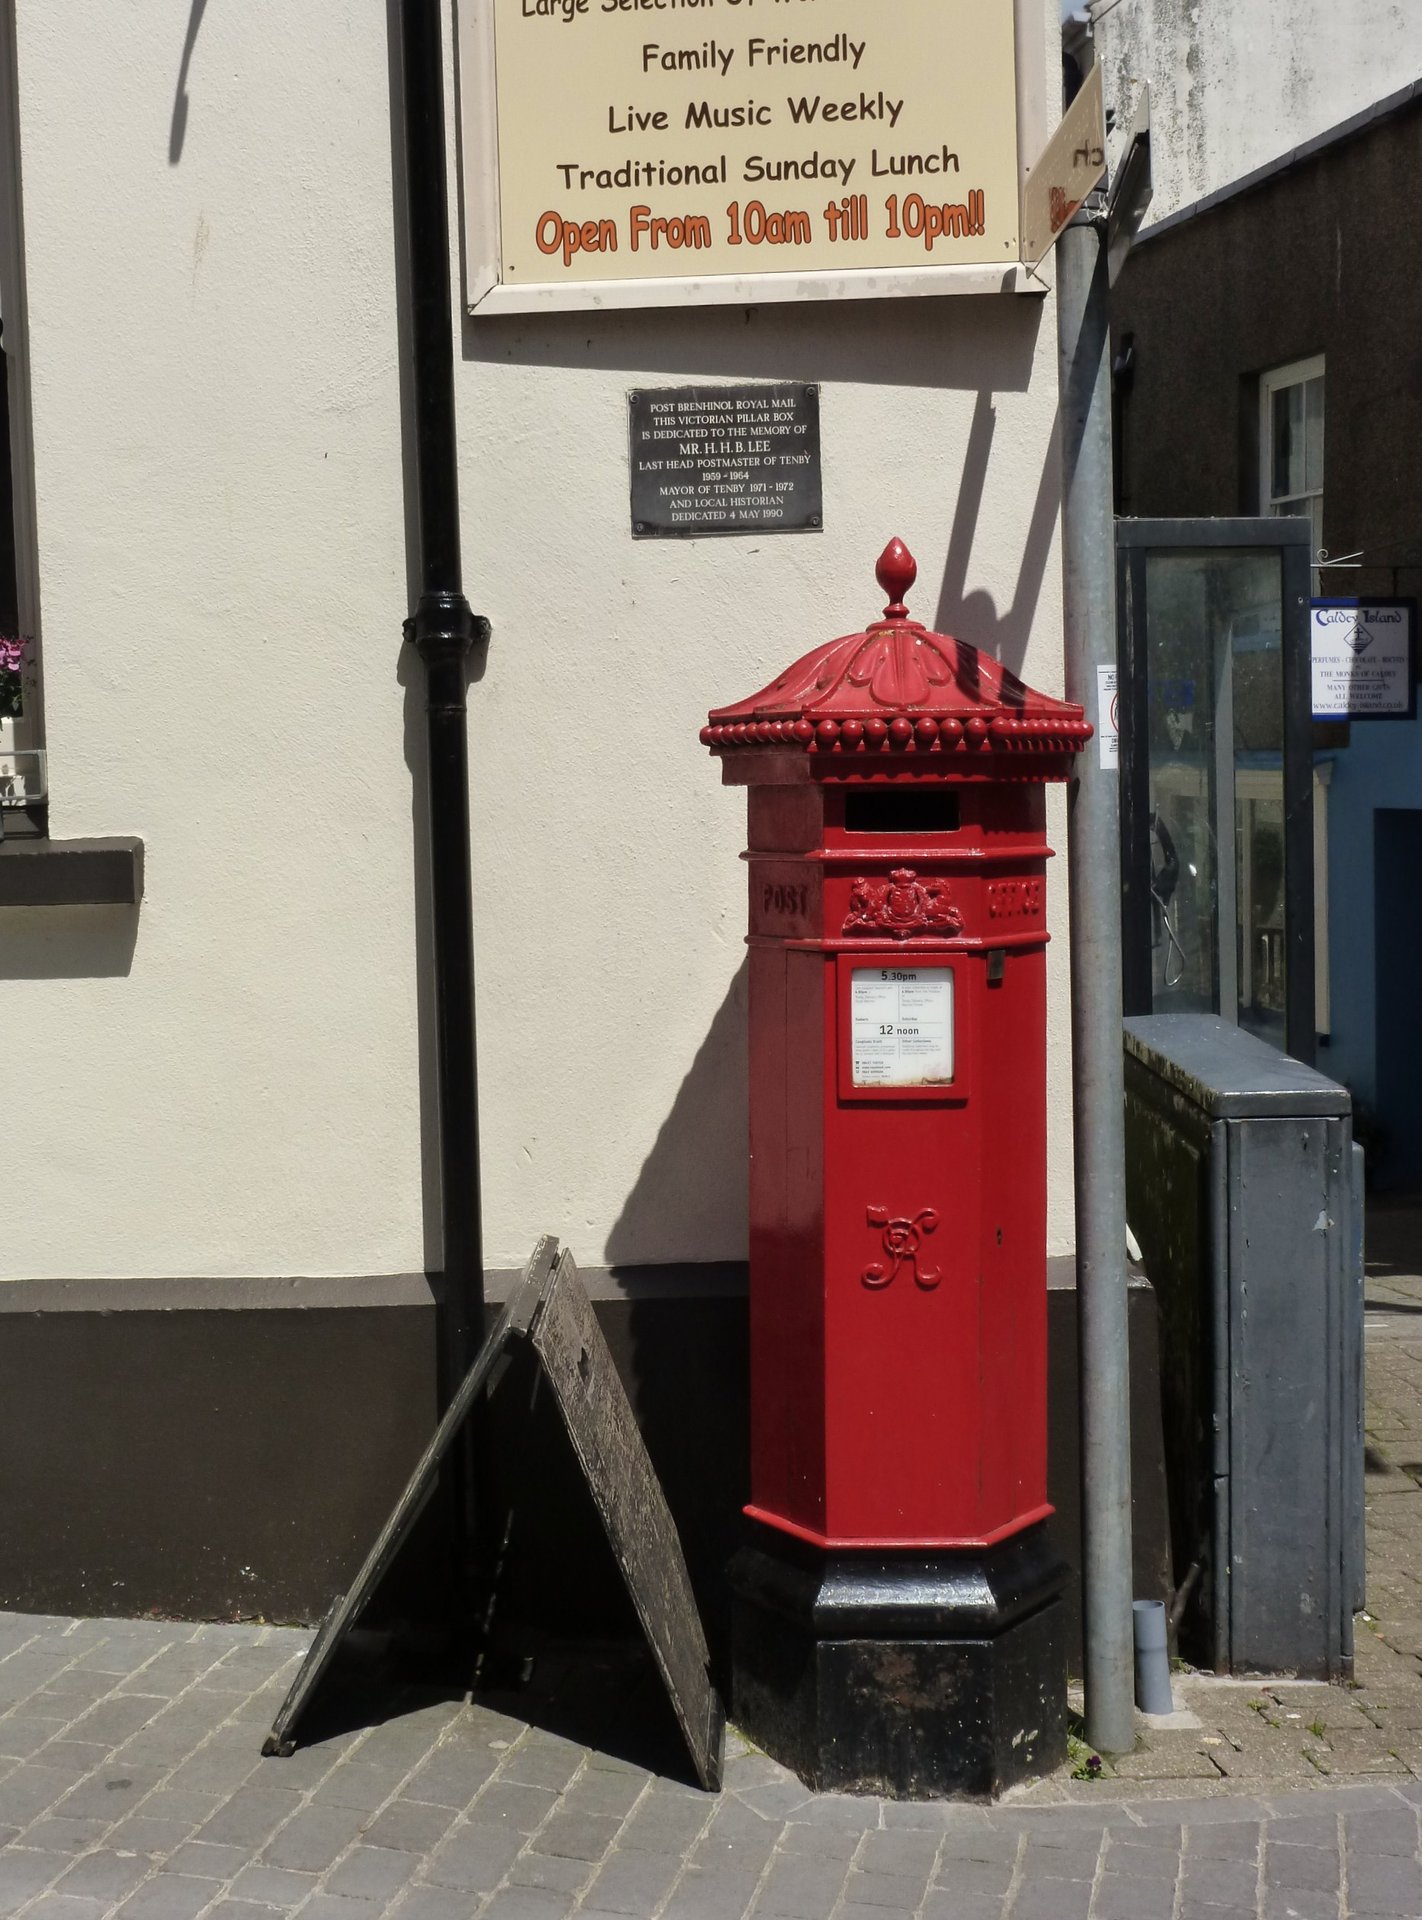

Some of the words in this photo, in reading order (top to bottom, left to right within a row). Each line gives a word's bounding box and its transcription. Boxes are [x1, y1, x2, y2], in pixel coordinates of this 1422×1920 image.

[642, 40, 735, 77] Family
[748, 32, 866, 70] Friendly
[608, 105, 669, 134] Live
[684, 99, 772, 130] Music
[786, 91, 904, 128] Weekly
[556, 154, 727, 190] Traditional
[743, 151, 856, 187] Sunday
[871, 144, 960, 177] Lunch
[535, 210, 618, 268] Open
[629, 204, 712, 252] From
[726, 199, 812, 246] 10am
[822, 193, 869, 243] till
[884, 188, 986, 252] 10pm!!
[651, 403, 675, 412] POST
[678, 401, 733, 412] BRENHINOL
[736, 400, 769, 409] ROYAL
[771, 399, 796, 408] MAIL
[653, 417, 675, 426] THIS
[678, 415, 733, 425] VICTORIAN
[737, 414, 770, 423] PILLAR
[773, 412, 794, 421] BOX
[642, 431, 650, 440] IS
[654, 429, 708, 439] DEDICATED
[711, 428, 725, 437] TO
[729, 428, 747, 436] THE
[750, 426, 791, 435] MEMORY
[794, 425, 807, 434] OF
[749, 441, 771, 452] LEE
[639, 461, 663, 470] LAST
[667, 461, 693, 469] HEAD
[697, 458, 760, 468] POSTMASTER
[764, 457, 777, 465] OF
[779, 455, 811, 465] TENBY
[660, 486, 695, 496] MAYOR
[698, 486, 710, 494] OF
[714, 484, 745, 493] TENBY
[750, 484, 766, 492] 1971
[775, 482, 794, 491] 1972
[670, 500, 692, 508] AND
[695, 499, 728, 508] LOCAL
[731, 496, 783, 506] HISTORIAN
[671, 511, 726, 521] DEDICATED
[739, 510, 760, 519] MAY
[763, 509, 783, 518] 1990
[1316, 608, 1358, 626] Caldey
[1362, 610, 1402, 623] Island
[764, 884, 808, 916] POST
[879, 1024, 893, 1035] 12
[896, 1027, 919, 1035] noon
